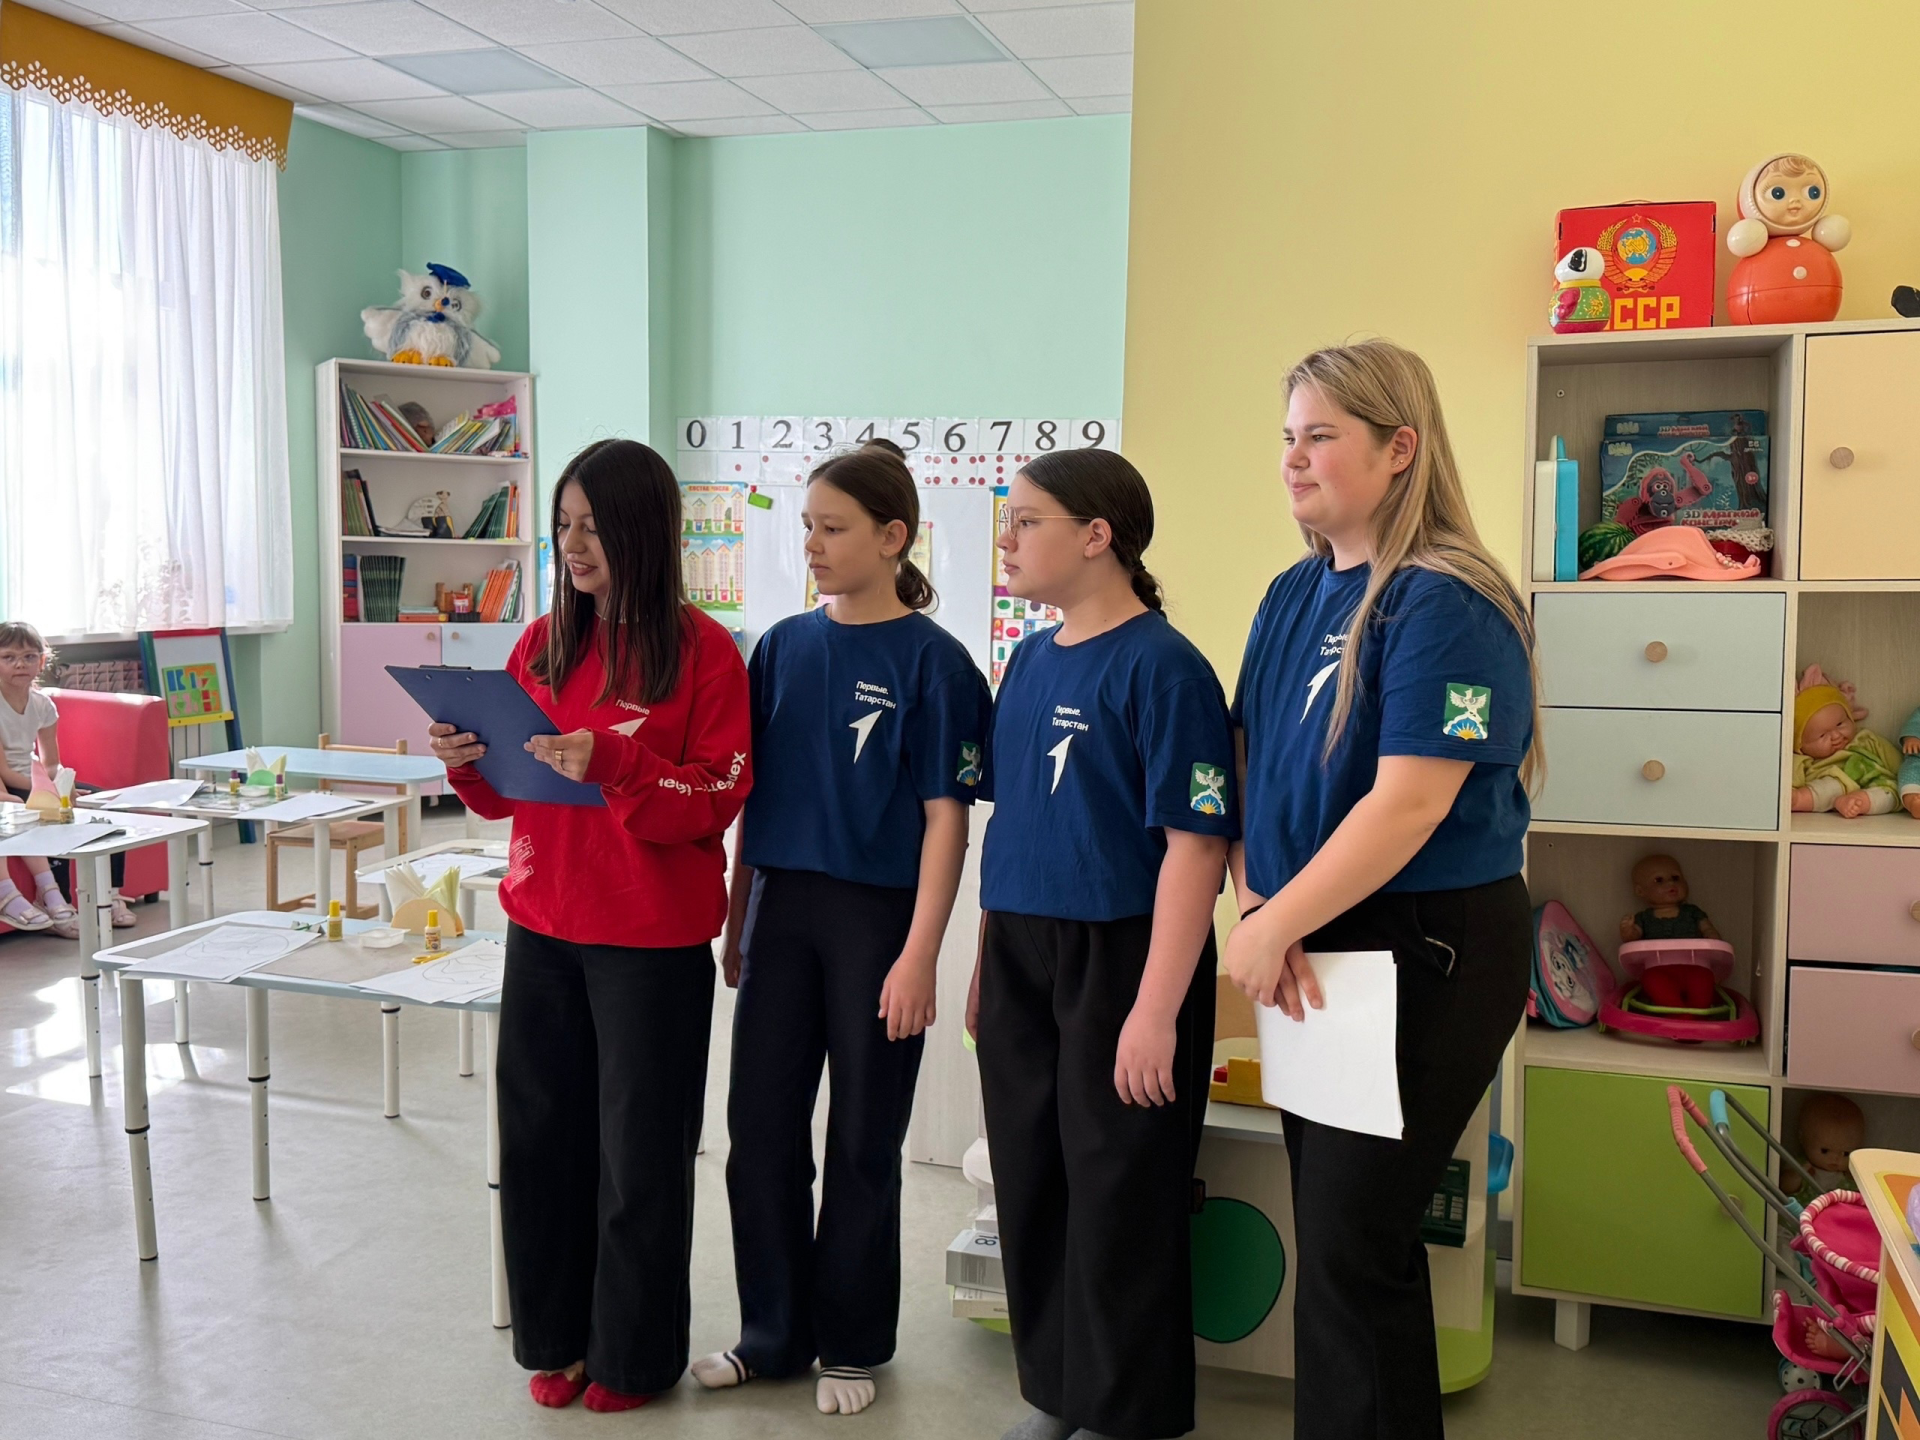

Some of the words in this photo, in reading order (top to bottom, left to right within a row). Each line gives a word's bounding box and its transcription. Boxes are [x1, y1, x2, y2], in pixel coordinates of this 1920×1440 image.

[1603, 296, 1680, 330] ССР
[686, 419, 707, 448] 0
[731, 420, 745, 449] 1
[772, 419, 793, 448] 2
[813, 421, 834, 451] 3
[855, 422, 875, 445] 4
[902, 421, 921, 450] 5
[944, 422, 967, 452] 6
[990, 420, 1013, 451] 7
[1035, 420, 1057, 450] 8
[1082, 420, 1106, 449] 9
[1684, 510, 1700, 519] 3D
[854, 691, 897, 709] Татарстан
[1052, 717, 1089, 732] Татарстан
[974, 1234, 1000, 1246] 18
